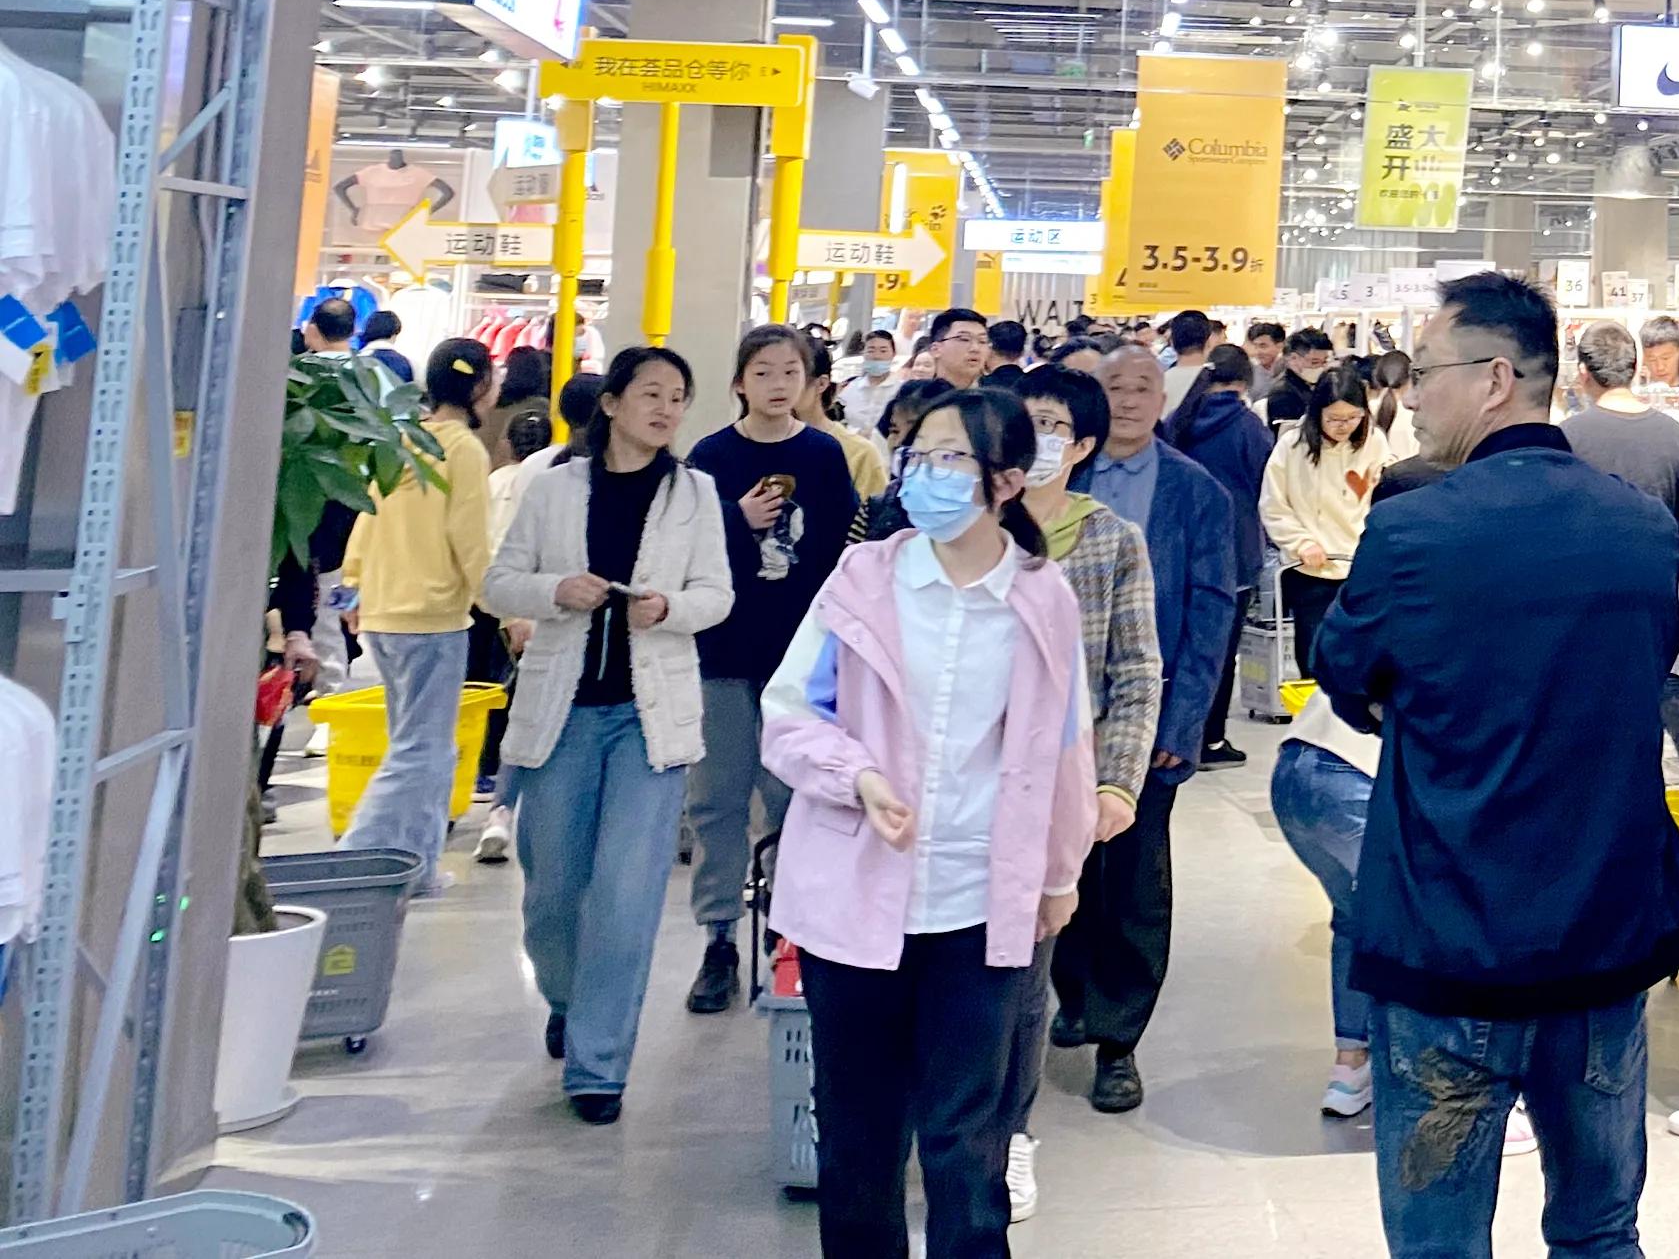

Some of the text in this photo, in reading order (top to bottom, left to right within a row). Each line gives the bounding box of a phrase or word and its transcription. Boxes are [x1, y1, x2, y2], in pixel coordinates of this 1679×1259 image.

[594, 56, 750, 81] 我在荟品仓等你
[1188, 137, 1268, 157] Columbia
[444, 232, 522, 256] 运动鞋
[825, 242, 895, 266] 运动鞋
[1142, 245, 1265, 274] 3.5-3.9折
